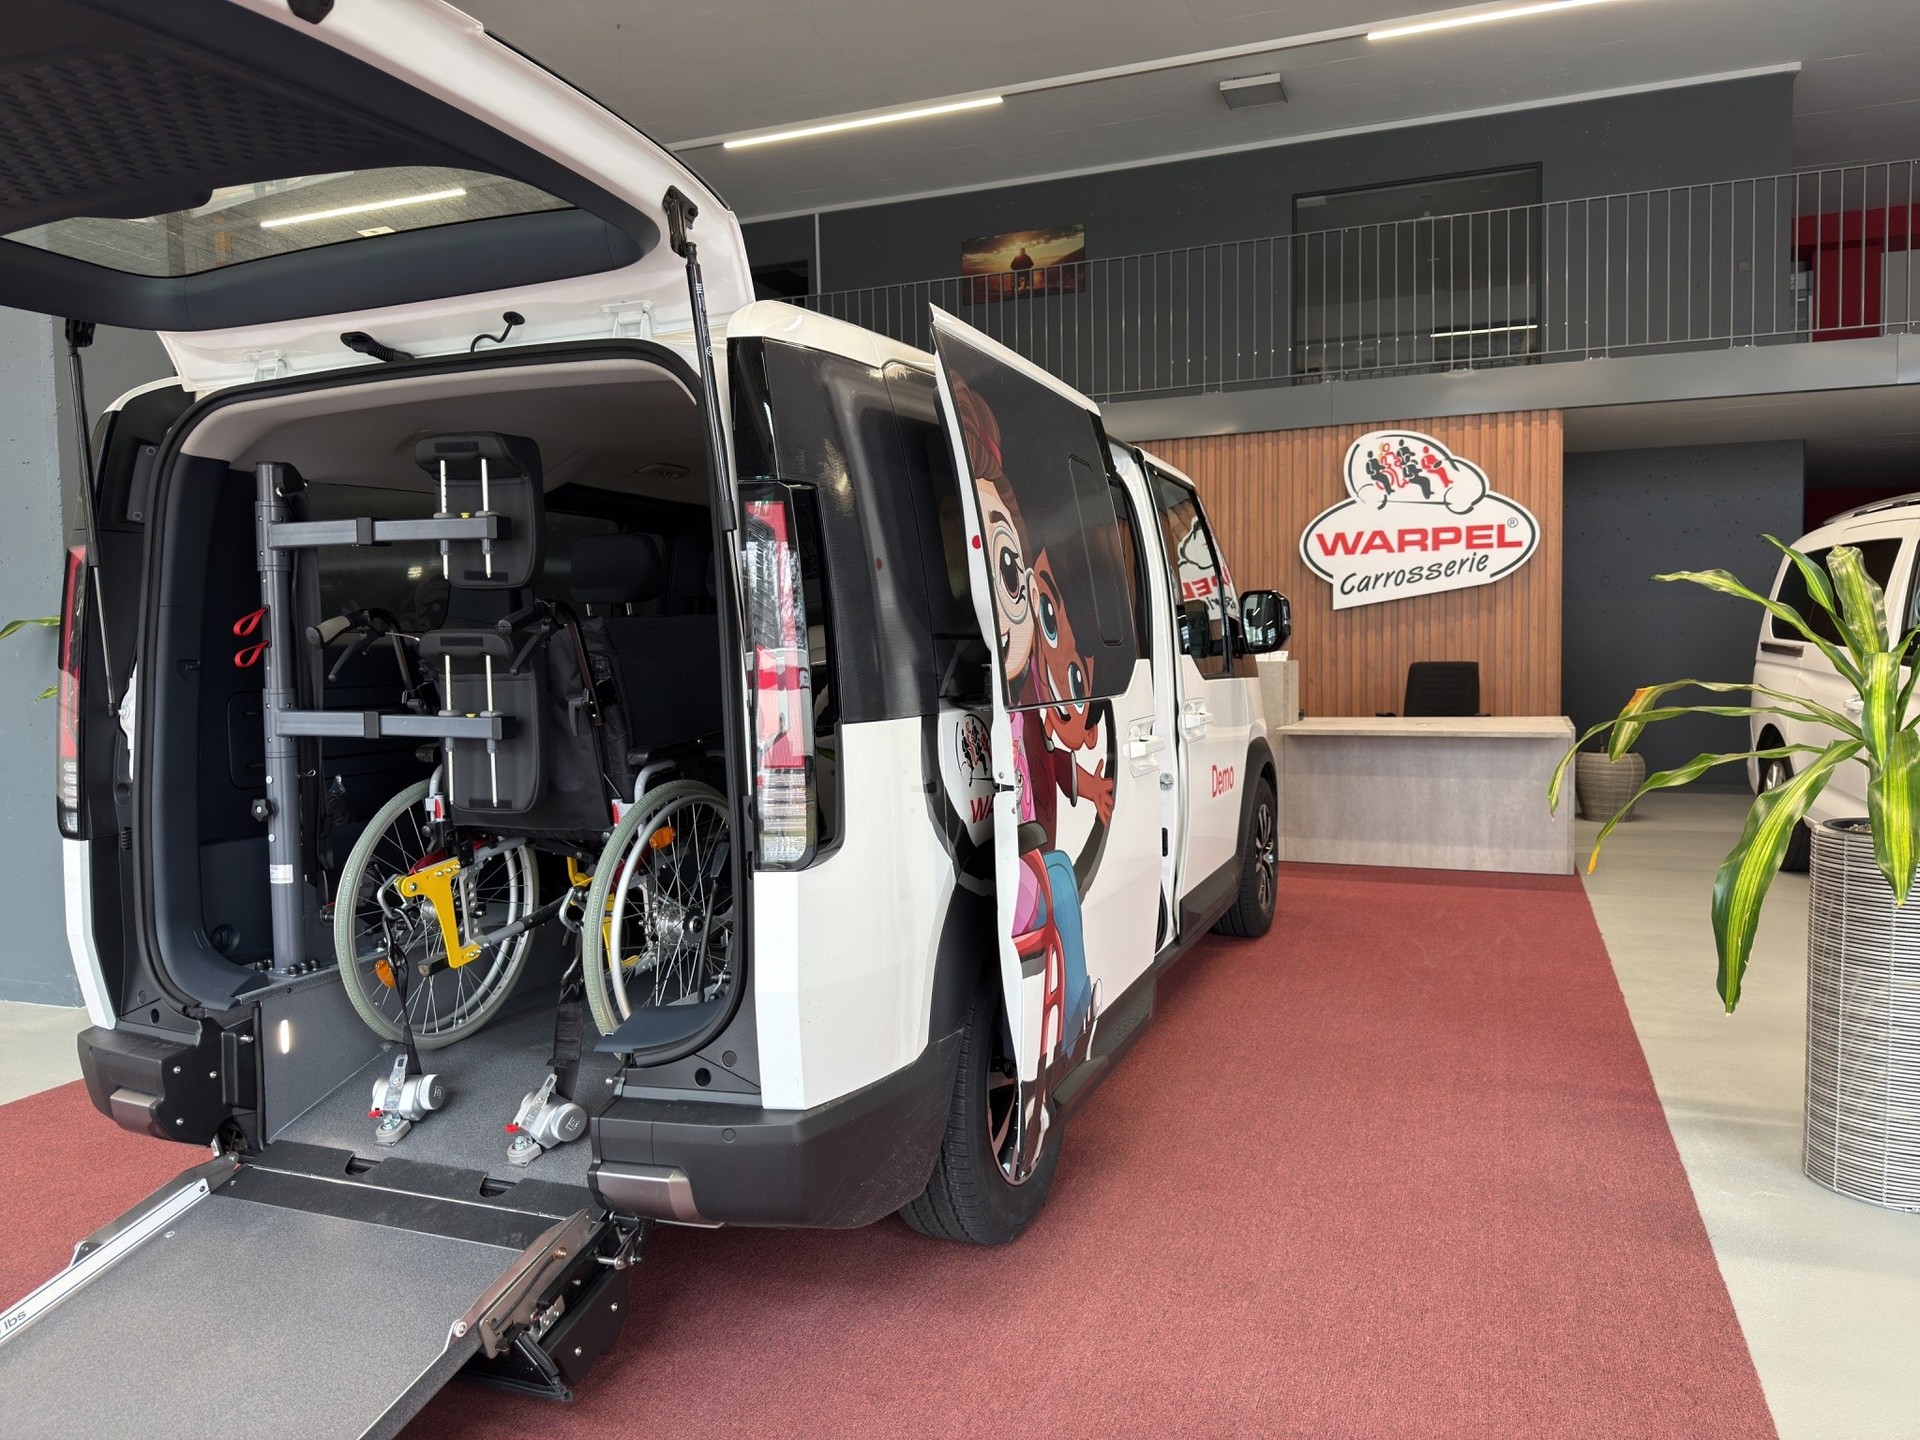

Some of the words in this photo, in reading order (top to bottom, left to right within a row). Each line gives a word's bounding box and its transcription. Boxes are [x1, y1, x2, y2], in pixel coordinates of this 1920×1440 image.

[1316, 524, 1523, 556] WARPEL
[1340, 552, 1490, 596] Carrosserie
[1211, 764, 1235, 798] Demo
[3, 1310, 26, 1330] lbs
